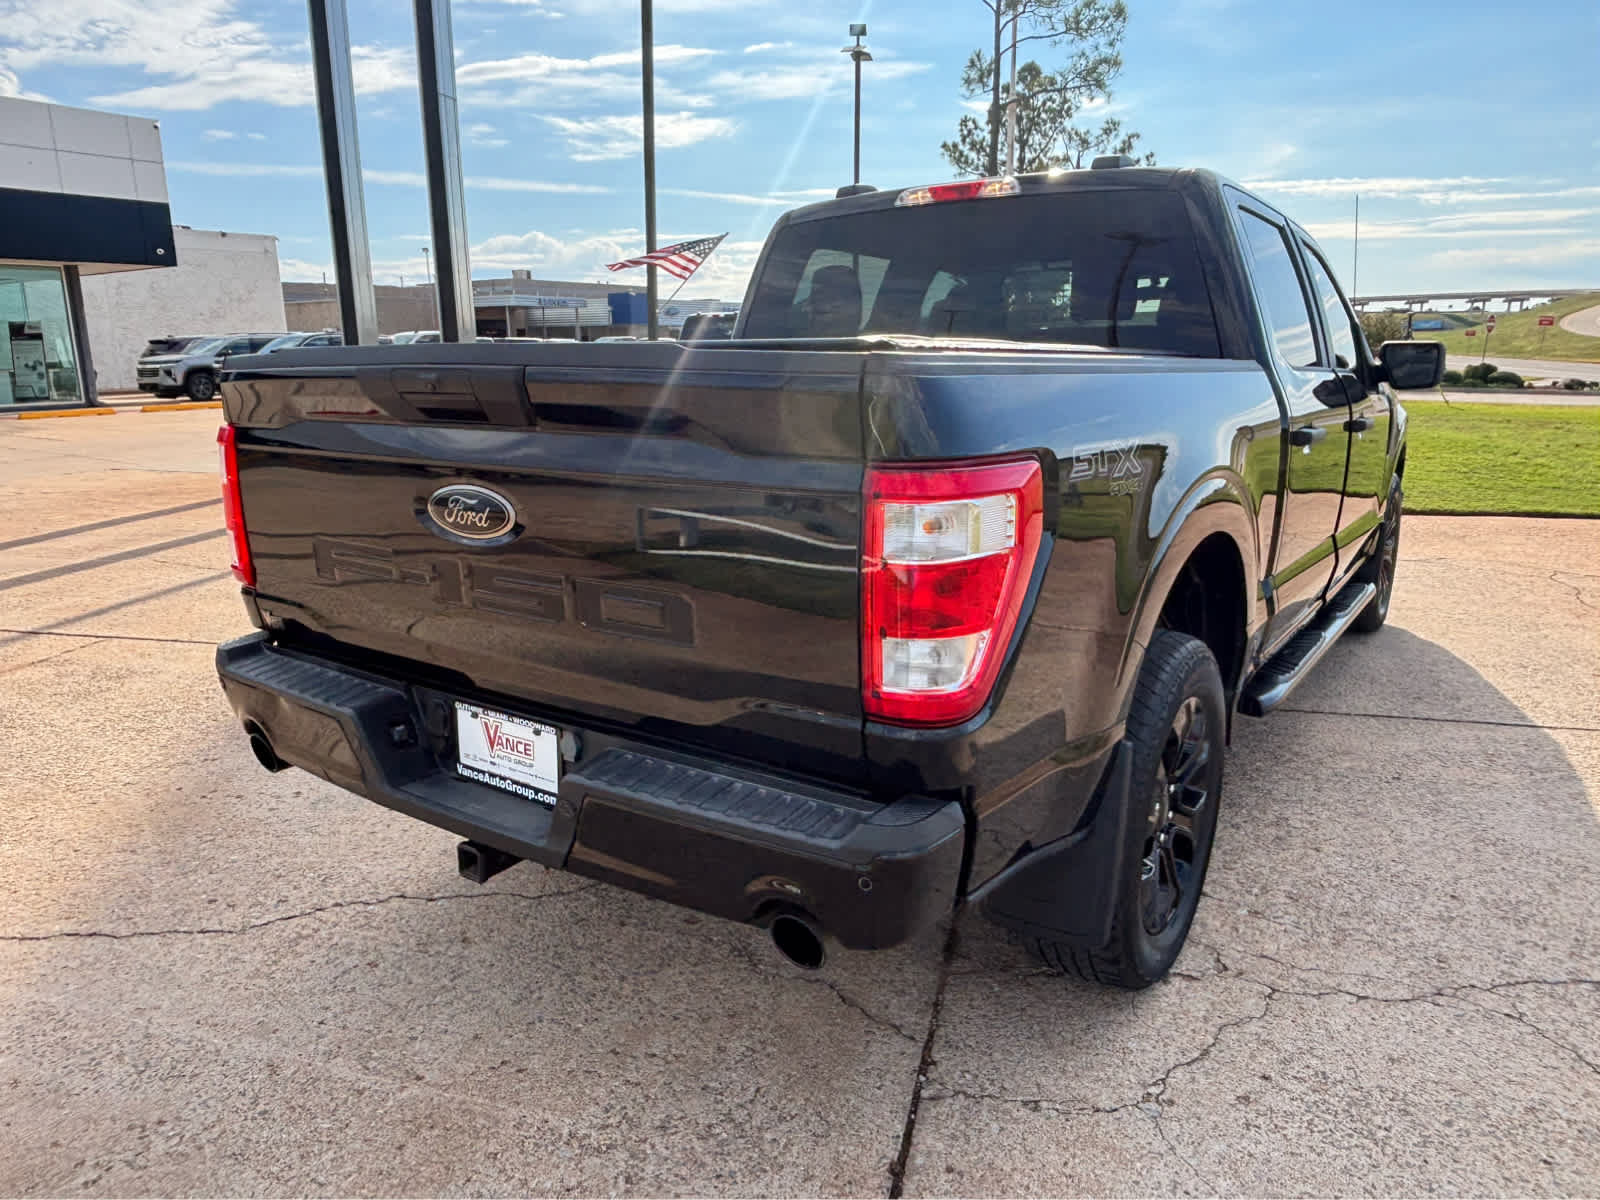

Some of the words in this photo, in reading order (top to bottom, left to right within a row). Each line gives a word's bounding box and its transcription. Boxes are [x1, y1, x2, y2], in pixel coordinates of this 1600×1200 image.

[1070, 440, 1143, 481] STX
[444, 495, 490, 527] Ford
[313, 536, 696, 647] F-150
[483, 719, 532, 757] VANCE
[512, 716, 556, 735] WOODWARD
[496, 753, 512, 763] AUTO
[513, 758, 534, 768] GROUP
[456, 762, 557, 805] VanceAutoGroup.com
